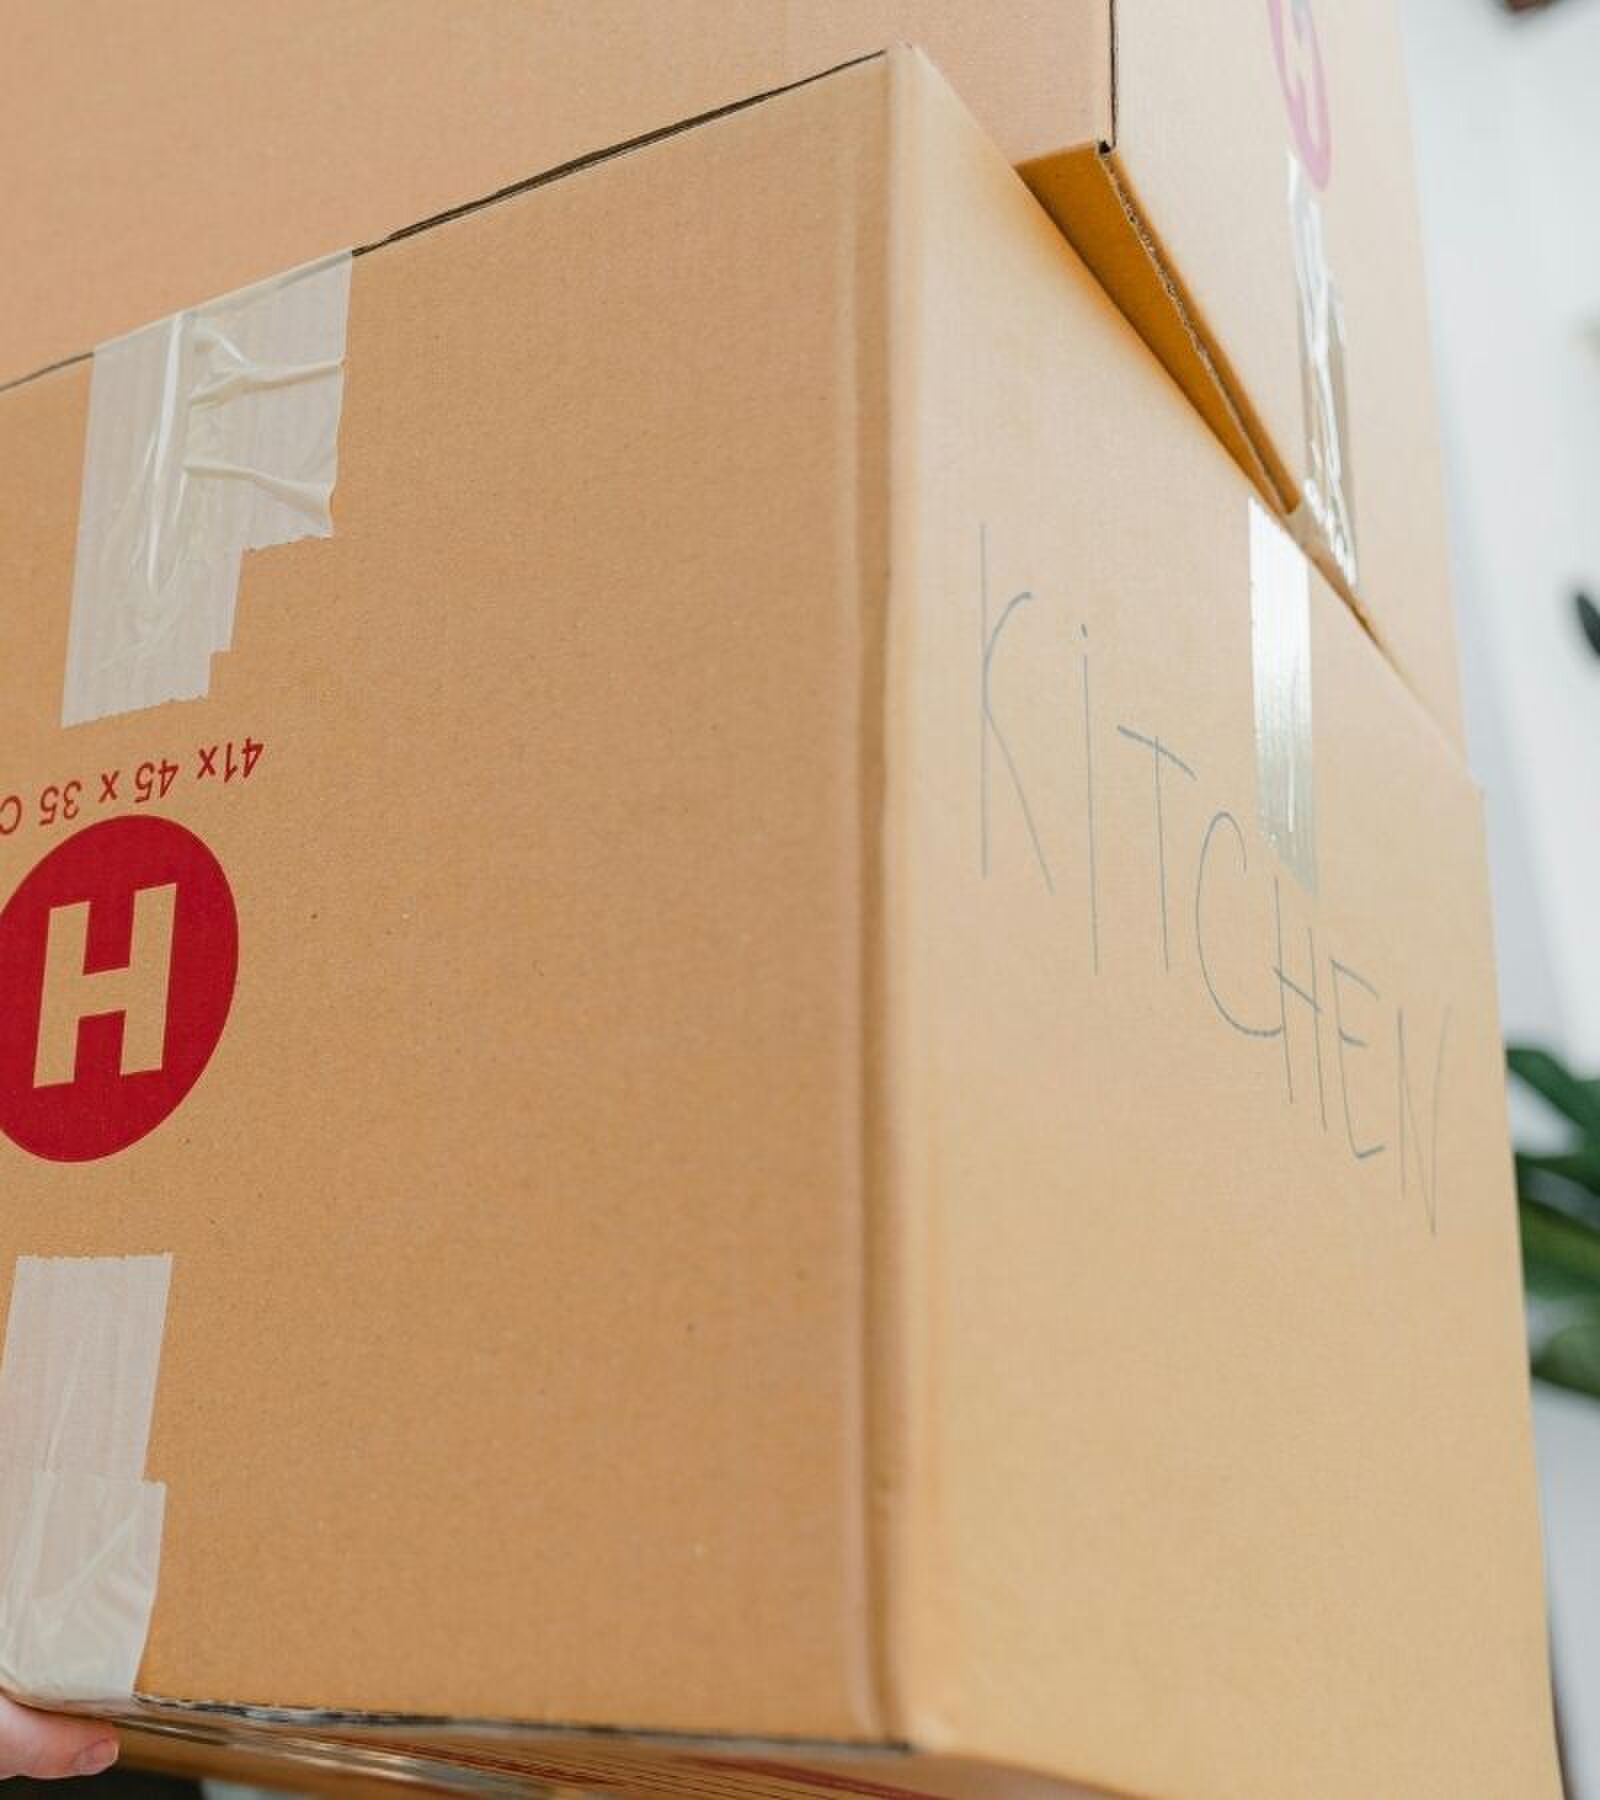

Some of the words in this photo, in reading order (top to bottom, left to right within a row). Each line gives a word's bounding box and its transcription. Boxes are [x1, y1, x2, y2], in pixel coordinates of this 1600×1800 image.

[134, 758, 180, 804] 45
[197, 736, 264, 783] 41x
[39, 780, 82, 826] 35
[97, 770, 121, 804] x
[33, 882, 177, 1089] H
